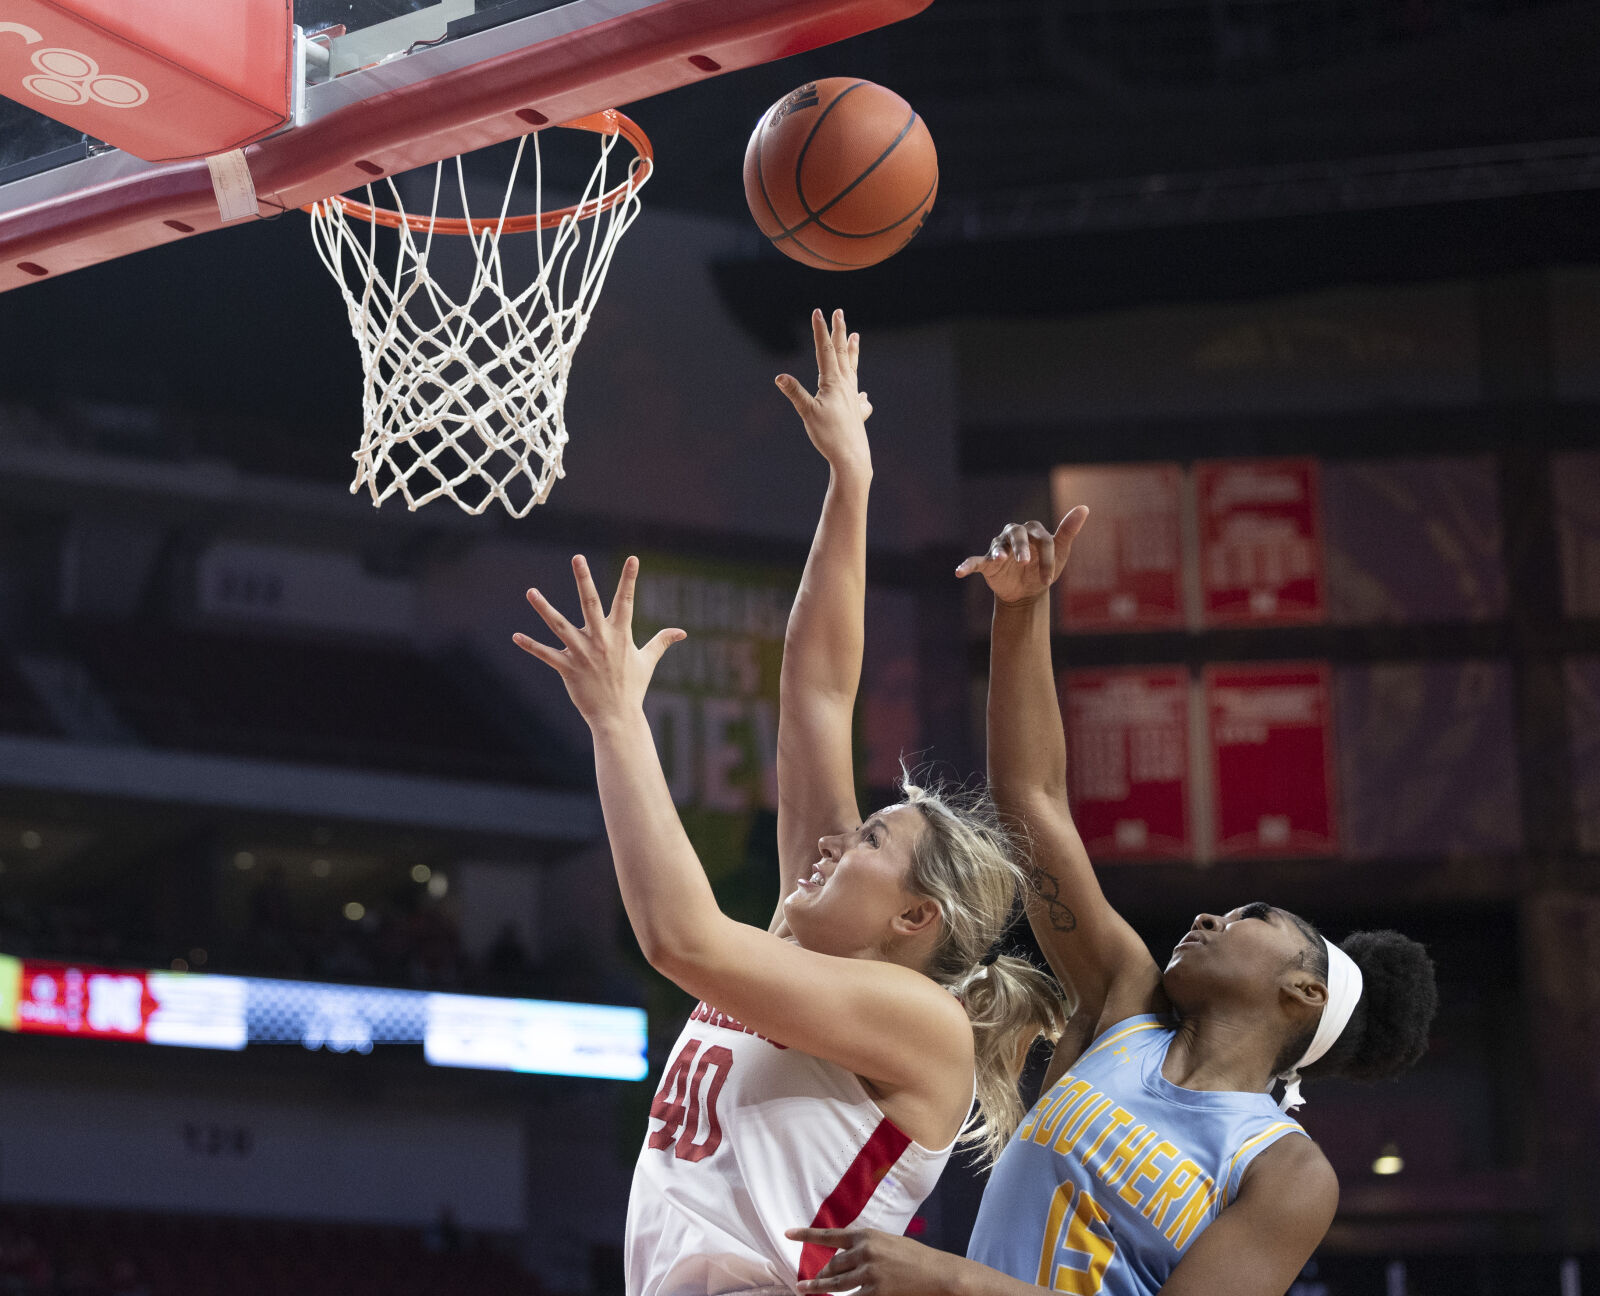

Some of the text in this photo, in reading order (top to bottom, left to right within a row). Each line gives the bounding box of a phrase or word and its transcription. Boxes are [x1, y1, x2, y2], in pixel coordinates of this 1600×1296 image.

[648, 1038, 734, 1163] 40
[1019, 1075, 1221, 1252] SOUTHERN
[1035, 1179, 1117, 1296] 15
